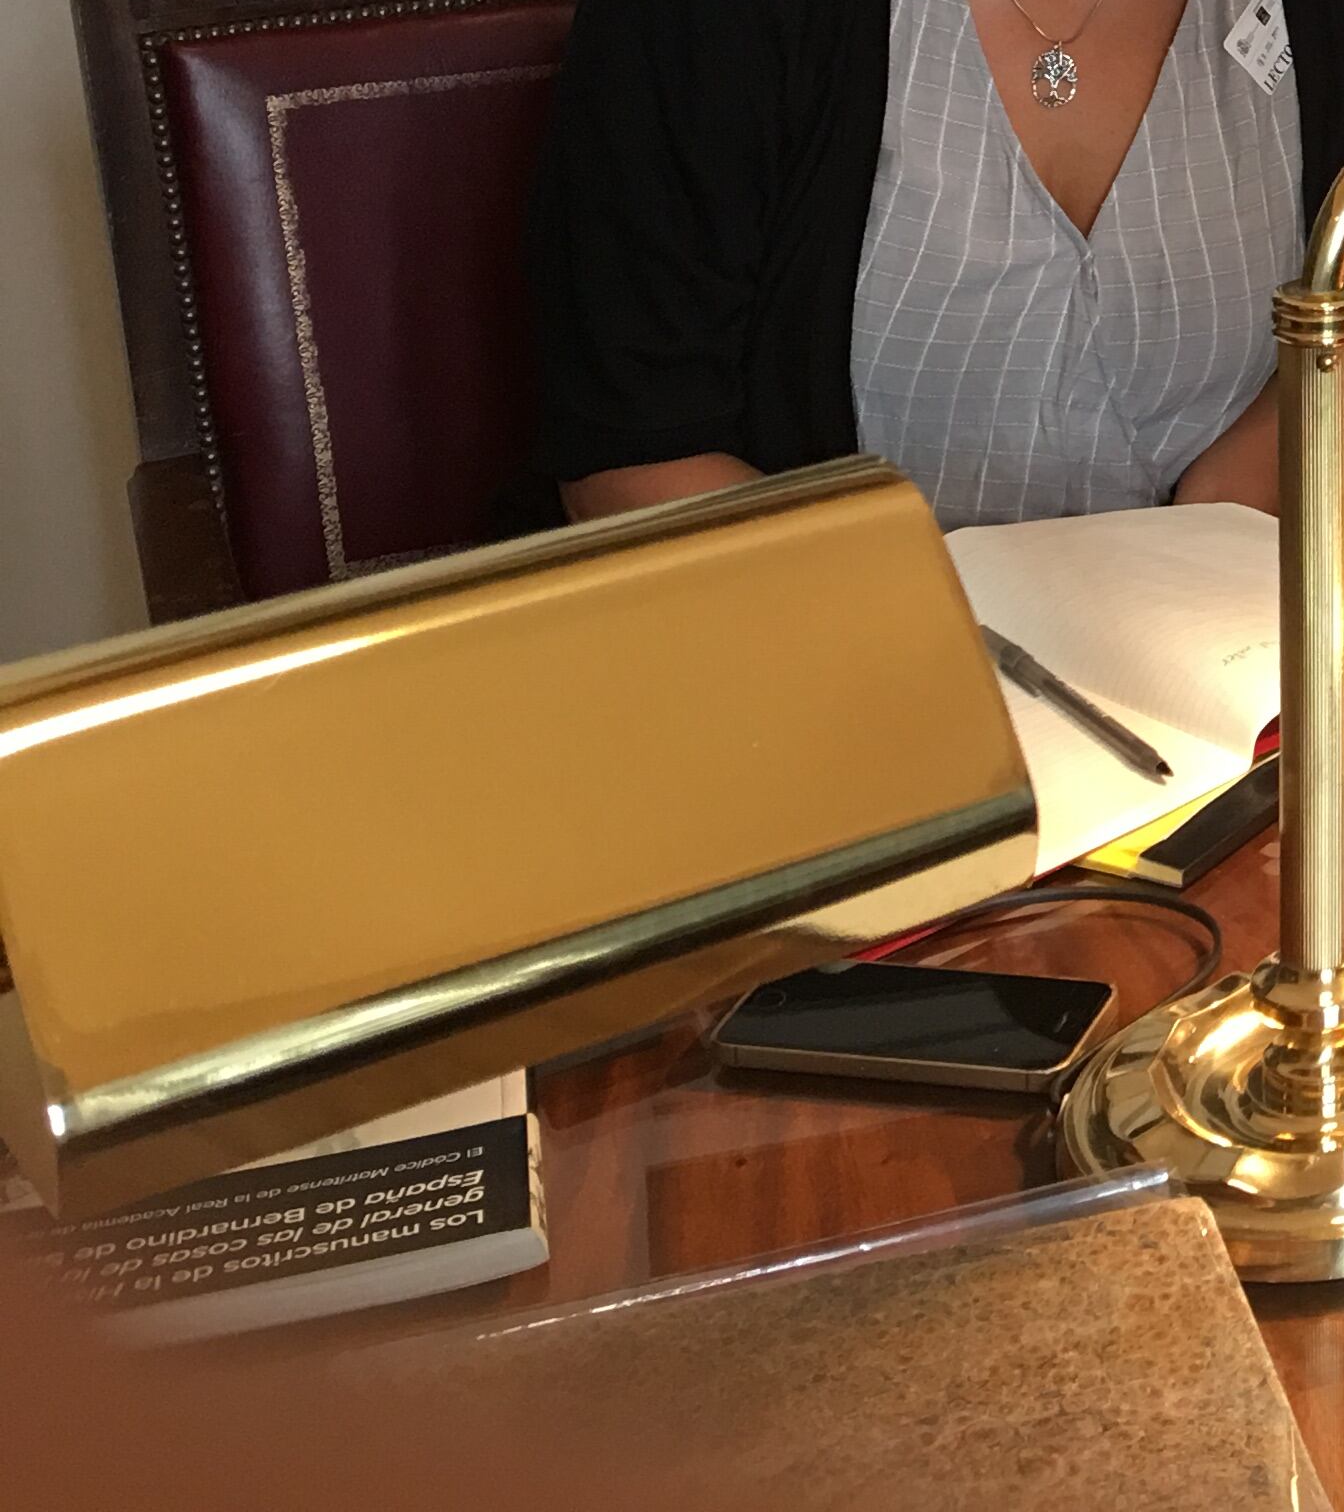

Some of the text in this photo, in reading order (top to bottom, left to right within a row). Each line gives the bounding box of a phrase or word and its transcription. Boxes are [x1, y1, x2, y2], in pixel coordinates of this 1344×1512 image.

[394, 1151, 462, 1172] Códice
[467, 1146, 484, 1158] El
[287, 1167, 389, 1194] Matritense
[366, 1169, 485, 1205] España
[233, 1192, 251, 1204] la
[256, 1187, 282, 1199] de
[186, 1198, 228, 1215] Real
[315, 1197, 356, 1215] de
[361, 1185, 485, 1230] general
[81, 1206, 181, 1232] Academia
[126, 1206, 305, 1250] Bernardino
[312, 1218, 354, 1237] de
[257, 1227, 304, 1248] las
[73, 1243, 116, 1263] de
[134, 1208, 484, 1291] Los manuscritos de la
[152, 1238, 248, 1261] cosas
[100, 1257, 143, 1277] de
